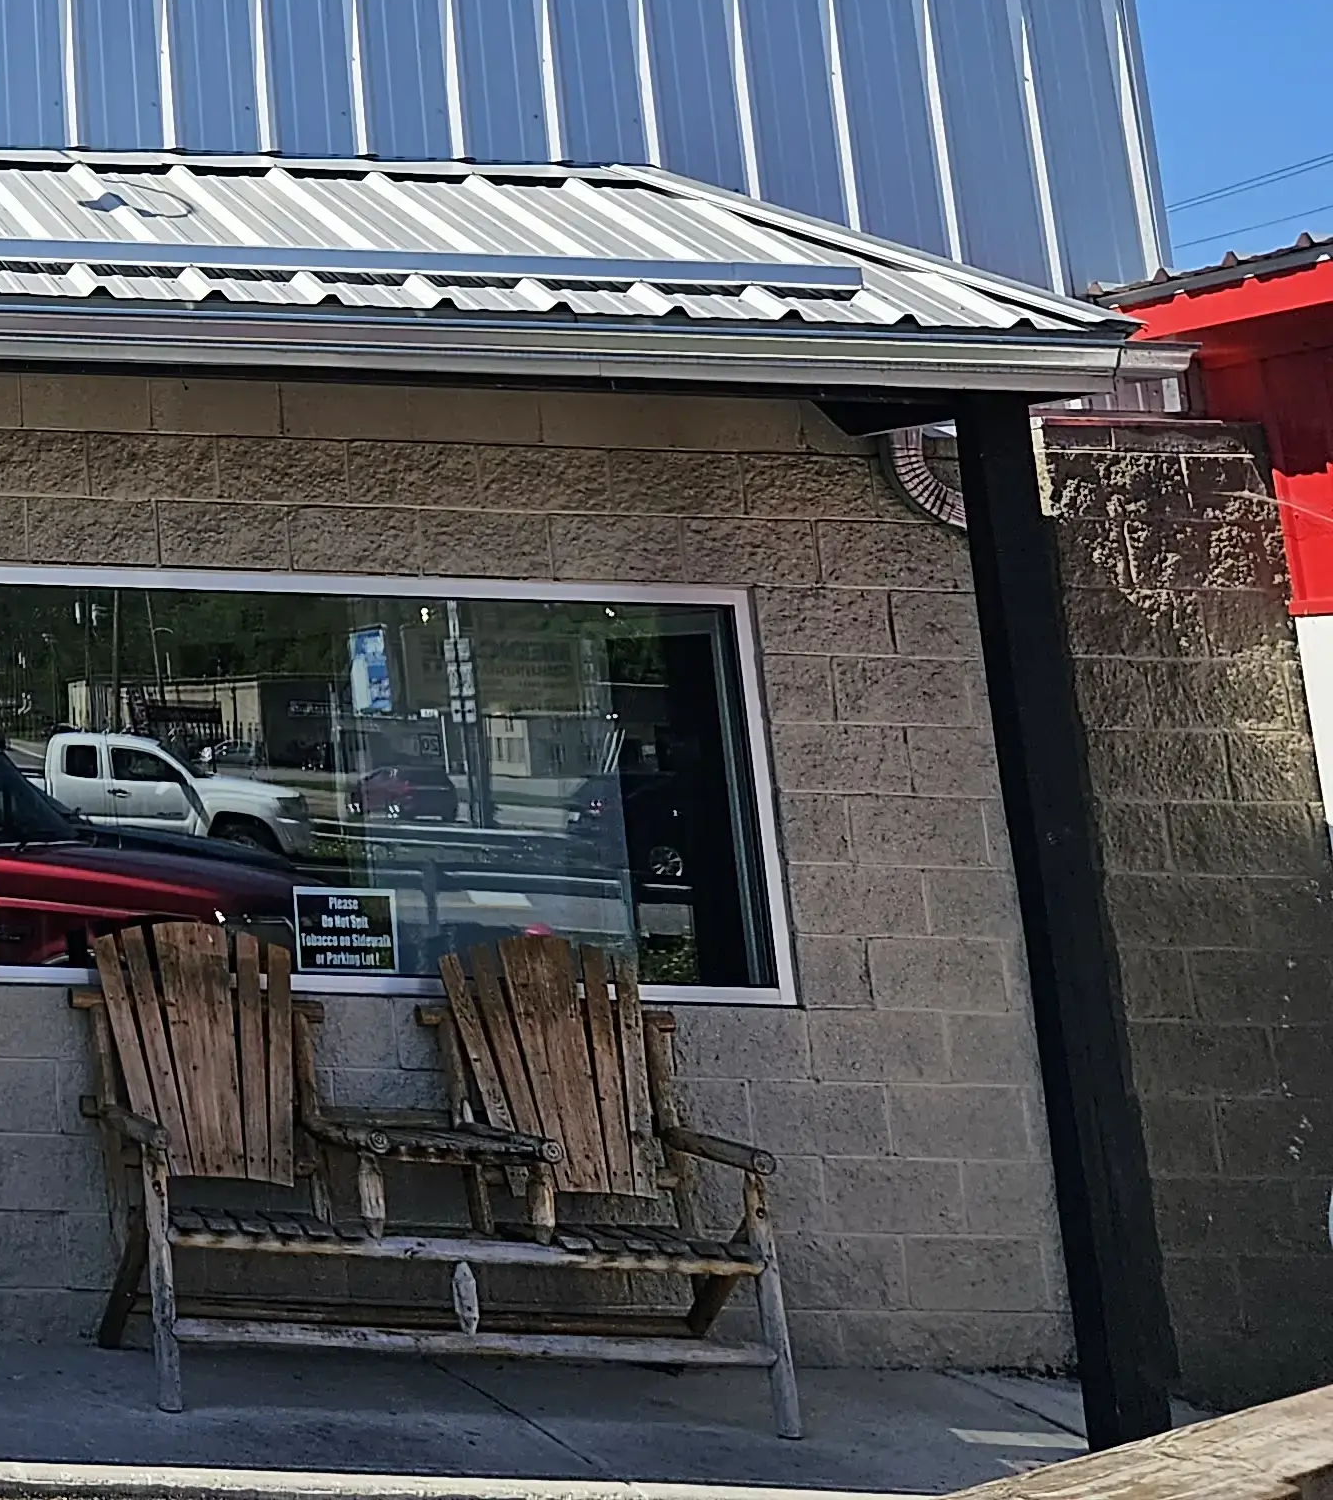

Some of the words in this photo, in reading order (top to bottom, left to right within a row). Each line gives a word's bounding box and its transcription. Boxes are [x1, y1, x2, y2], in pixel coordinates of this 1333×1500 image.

[328, 896, 359, 910] Please
[321, 914, 334, 928] Do
[334, 914, 350, 928] Not
[350, 914, 370, 929] Spit
[301, 933, 338, 947] Tobacco
[339, 935, 351, 947] on
[352, 933, 392, 948] Sidewalk
[316, 953, 325, 964] or
[326, 952, 361, 967] Parking
